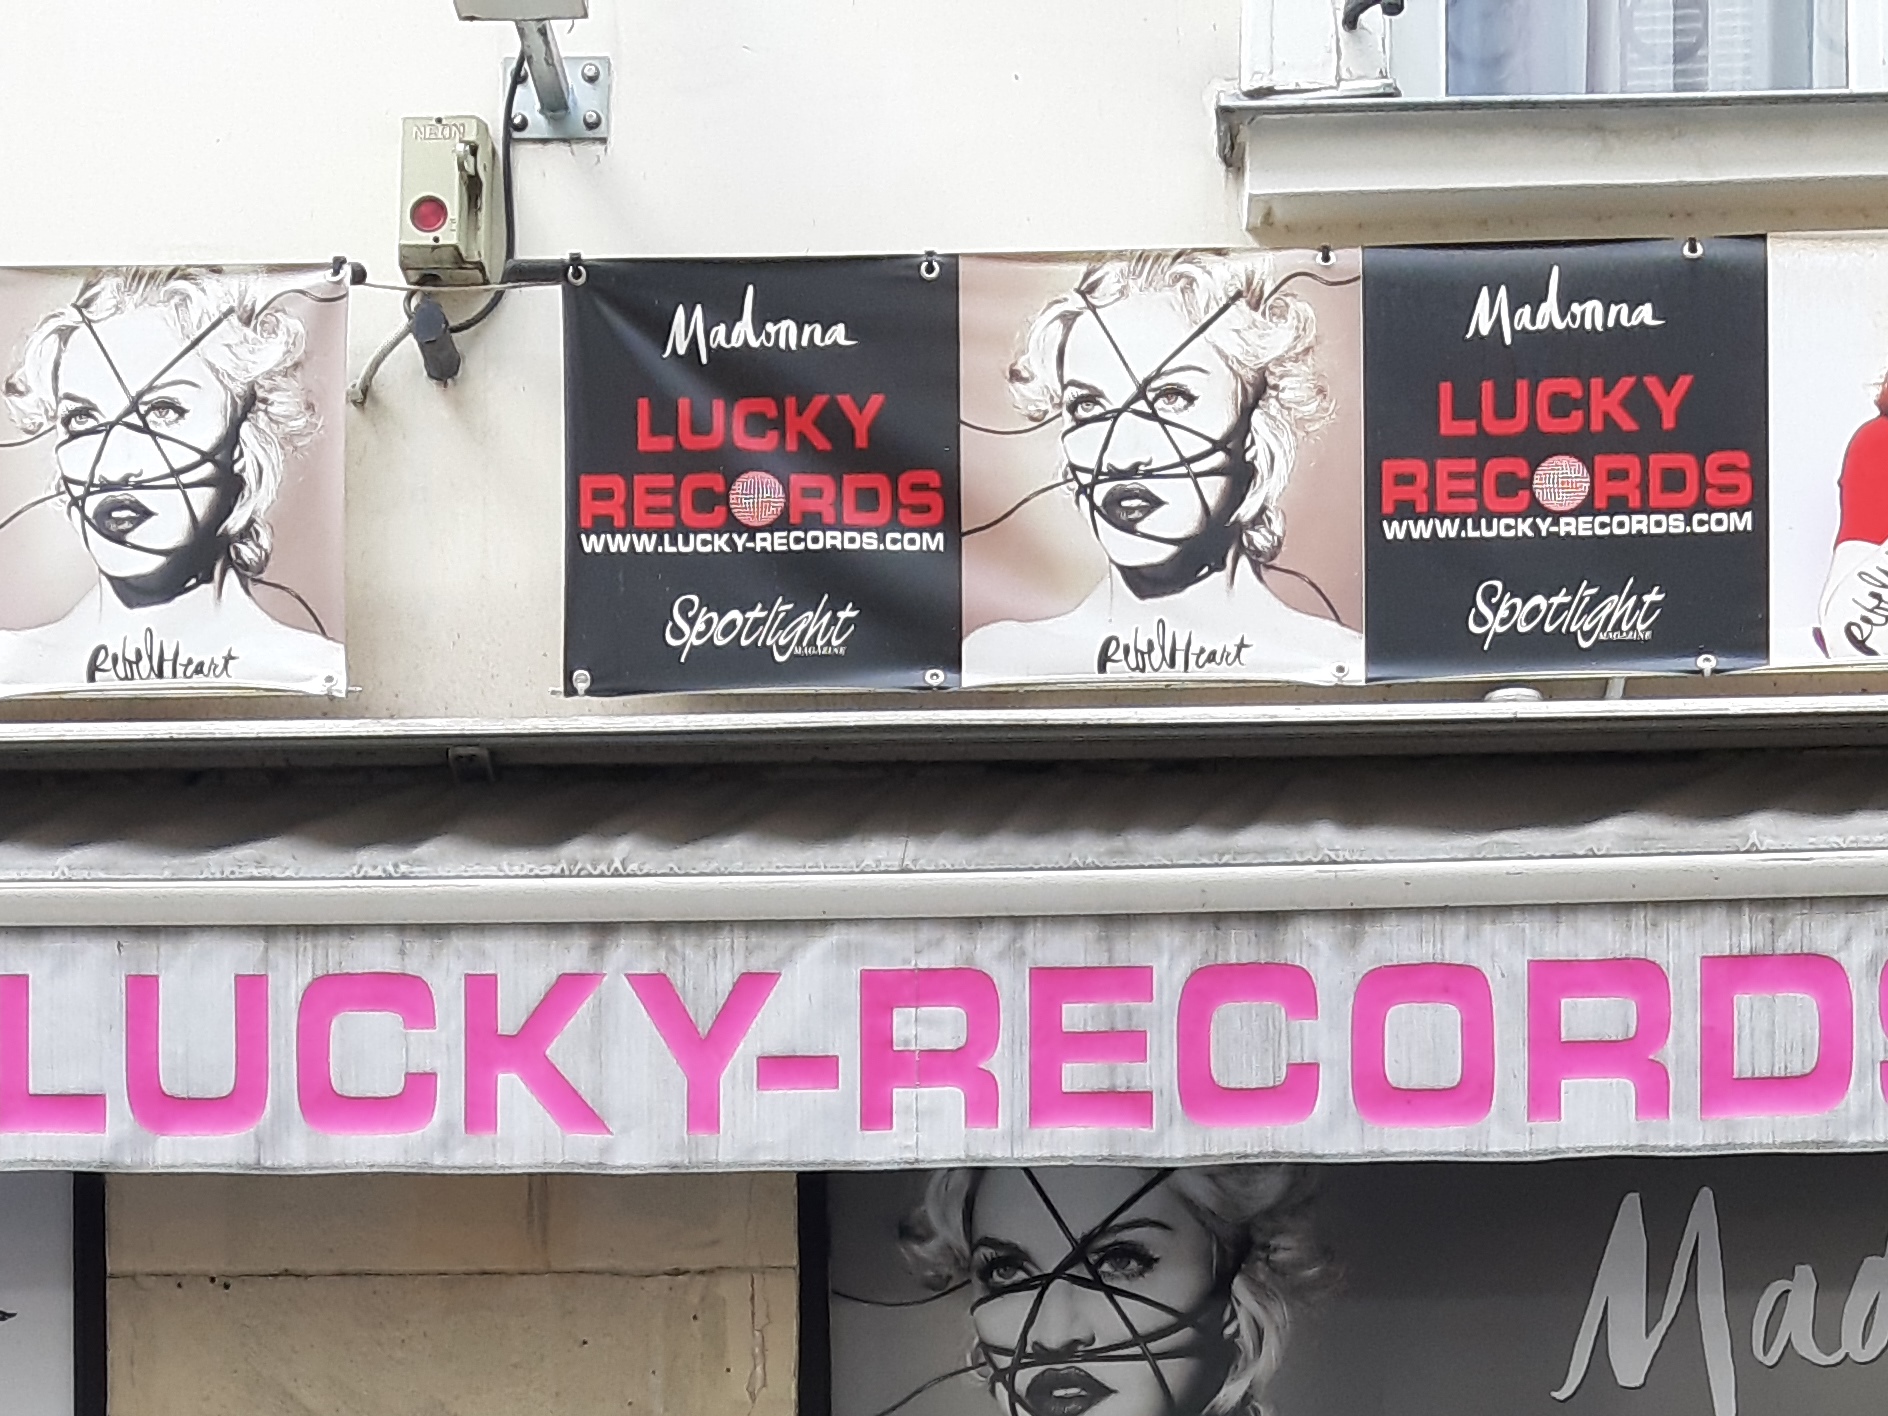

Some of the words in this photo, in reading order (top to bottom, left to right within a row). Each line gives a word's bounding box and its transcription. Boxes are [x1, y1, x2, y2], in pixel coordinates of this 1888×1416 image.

[413, 124, 465, 140] NEON
[662, 285, 857, 364] Madonna
[1466, 265, 1665, 345] Madonna
[638, 394, 884, 452] LUCKY
[1439, 375, 1693, 436] LUCKY
[580, 470, 944, 528] RECORDS
[1382, 451, 1753, 514] RECORDS
[581, 531, 943, 552] WWW.LUCKY-RECORDS.COM
[1383, 511, 1752, 539] WWW.LUCKY-RECORDS.COM
[665, 594, 859, 662] Spotlight
[1469, 577, 1665, 650] Spotlight
